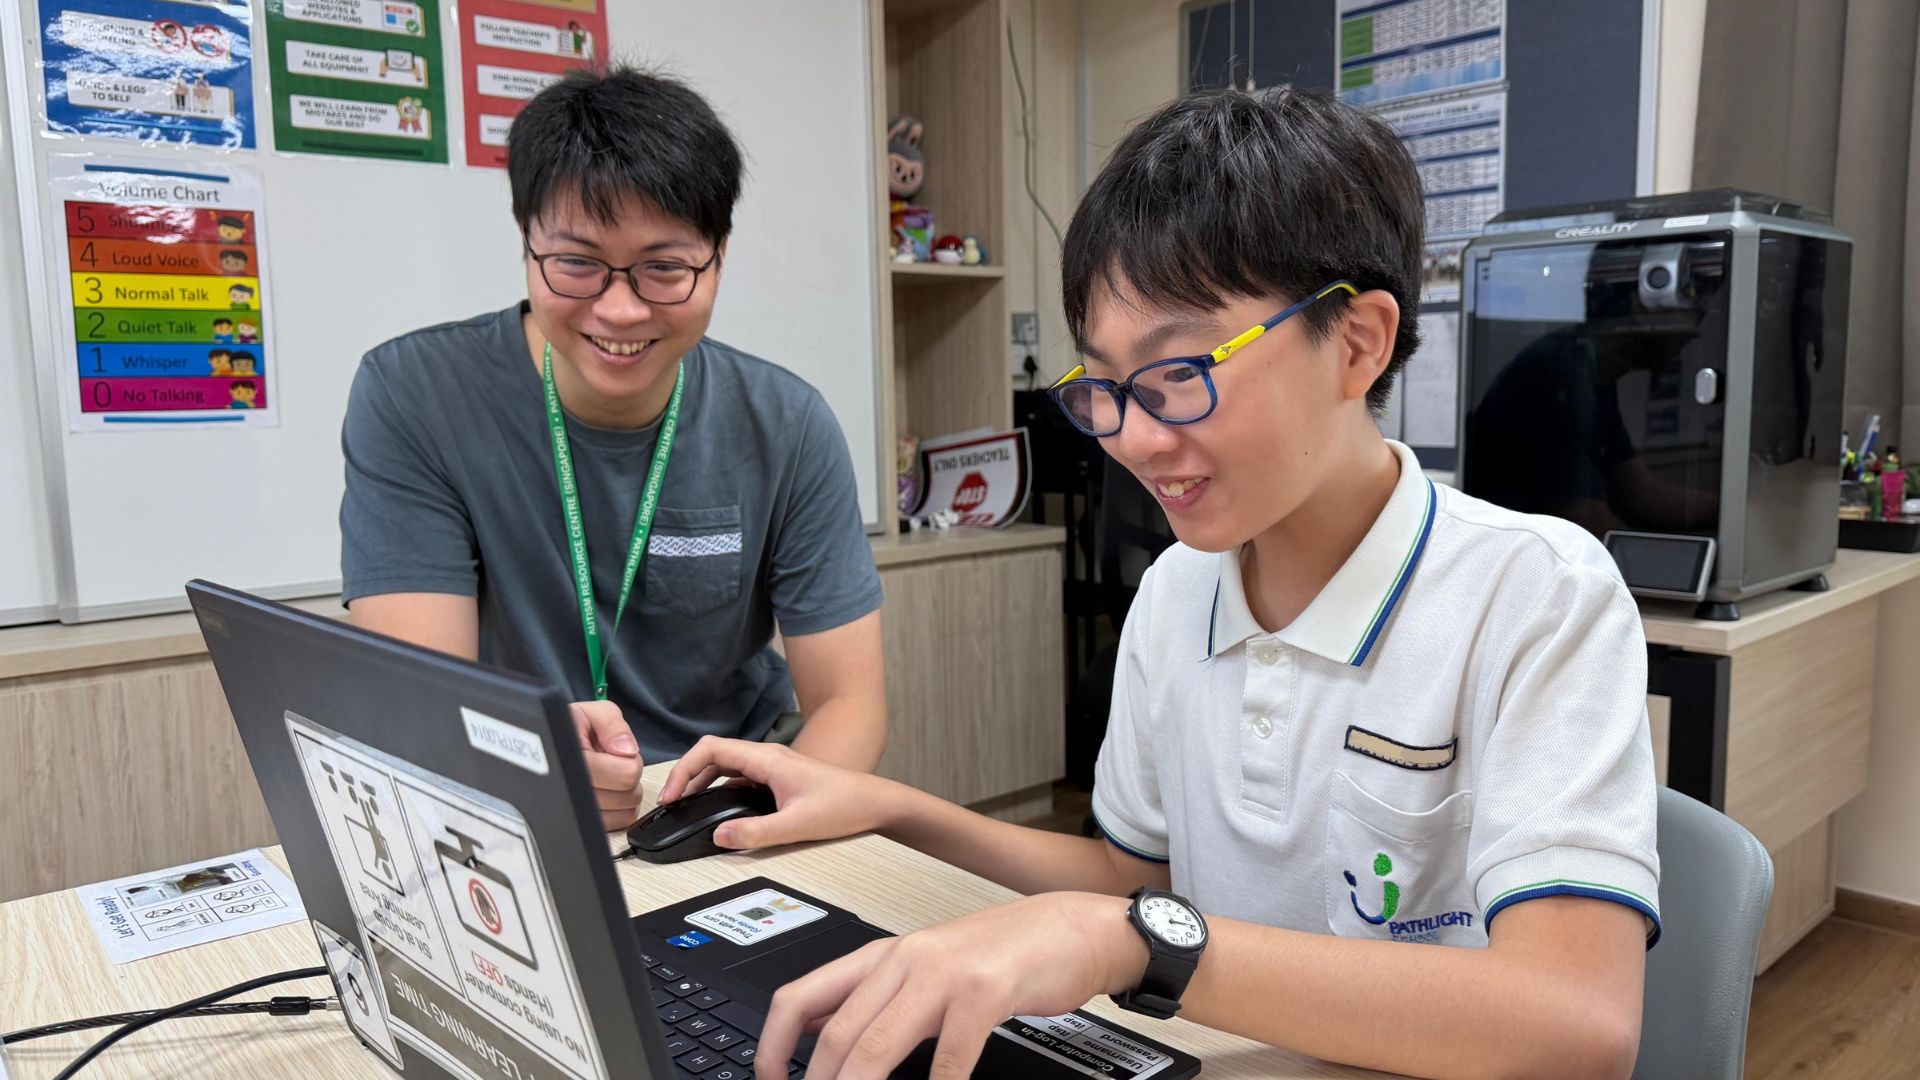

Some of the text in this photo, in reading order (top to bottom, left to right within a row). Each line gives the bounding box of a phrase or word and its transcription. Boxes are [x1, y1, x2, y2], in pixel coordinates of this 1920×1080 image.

[302, 60, 369, 74] ALL EQUIPMENT
[304, 50, 363, 63] TAKE CARE OF
[92, 92, 131, 102] TO SELF
[113, 84, 120, 92] &
[122, 85, 146, 94] LEGS
[336, 104, 363, 113] LEARN
[364, 106, 388, 115] FROM
[99, 181, 220, 203] Volume Chart
[77, 206, 96, 233] 5
[1555, 222, 1639, 239] CREALITY
[80, 242, 199, 268] 4 Loud Voice
[84, 277, 209, 304] 3 Normal Talk
[87, 311, 198, 339] 2 Quiet Talk
[91, 347, 189, 373] 1 Whisper
[93, 381, 205, 408] 0 No Talking
[658, 419, 676, 460] CENTRE
[554, 426, 576, 494] (SINGAPORE)
[934, 448, 1010, 471] TEACHERS ONLY
[640, 461, 665, 527] (SINGAPORE)
[956, 486, 986, 504] STOP
[566, 496, 582, 538] CENTRE
[573, 539, 590, 596] RESOURCE
[622, 538, 643, 592] PATHLIGHT
[583, 597, 597, 635] AUTISM
[359, 881, 431, 939] Learning Area
[1388, 911, 1474, 934] PATHLIGHT
[373, 908, 404, 941] Group
[415, 937, 433, 960] Sit
[504, 974, 554, 1019] (Hands
[390, 972, 521, 1080] LEARNING TIME
[464, 970, 589, 1064] No using computer
[691, 1020, 708, 1029] M
[714, 1034, 731, 1043] N
[1021, 1027, 1114, 1072] Computer Log-In
[1048, 1024, 1143, 1070] Username itsp
[1063, 1017, 1159, 1061] Password itsp
[692, 1055, 709, 1065] H
[741, 1049, 755, 1057] B
[718, 1071, 733, 1080] G
